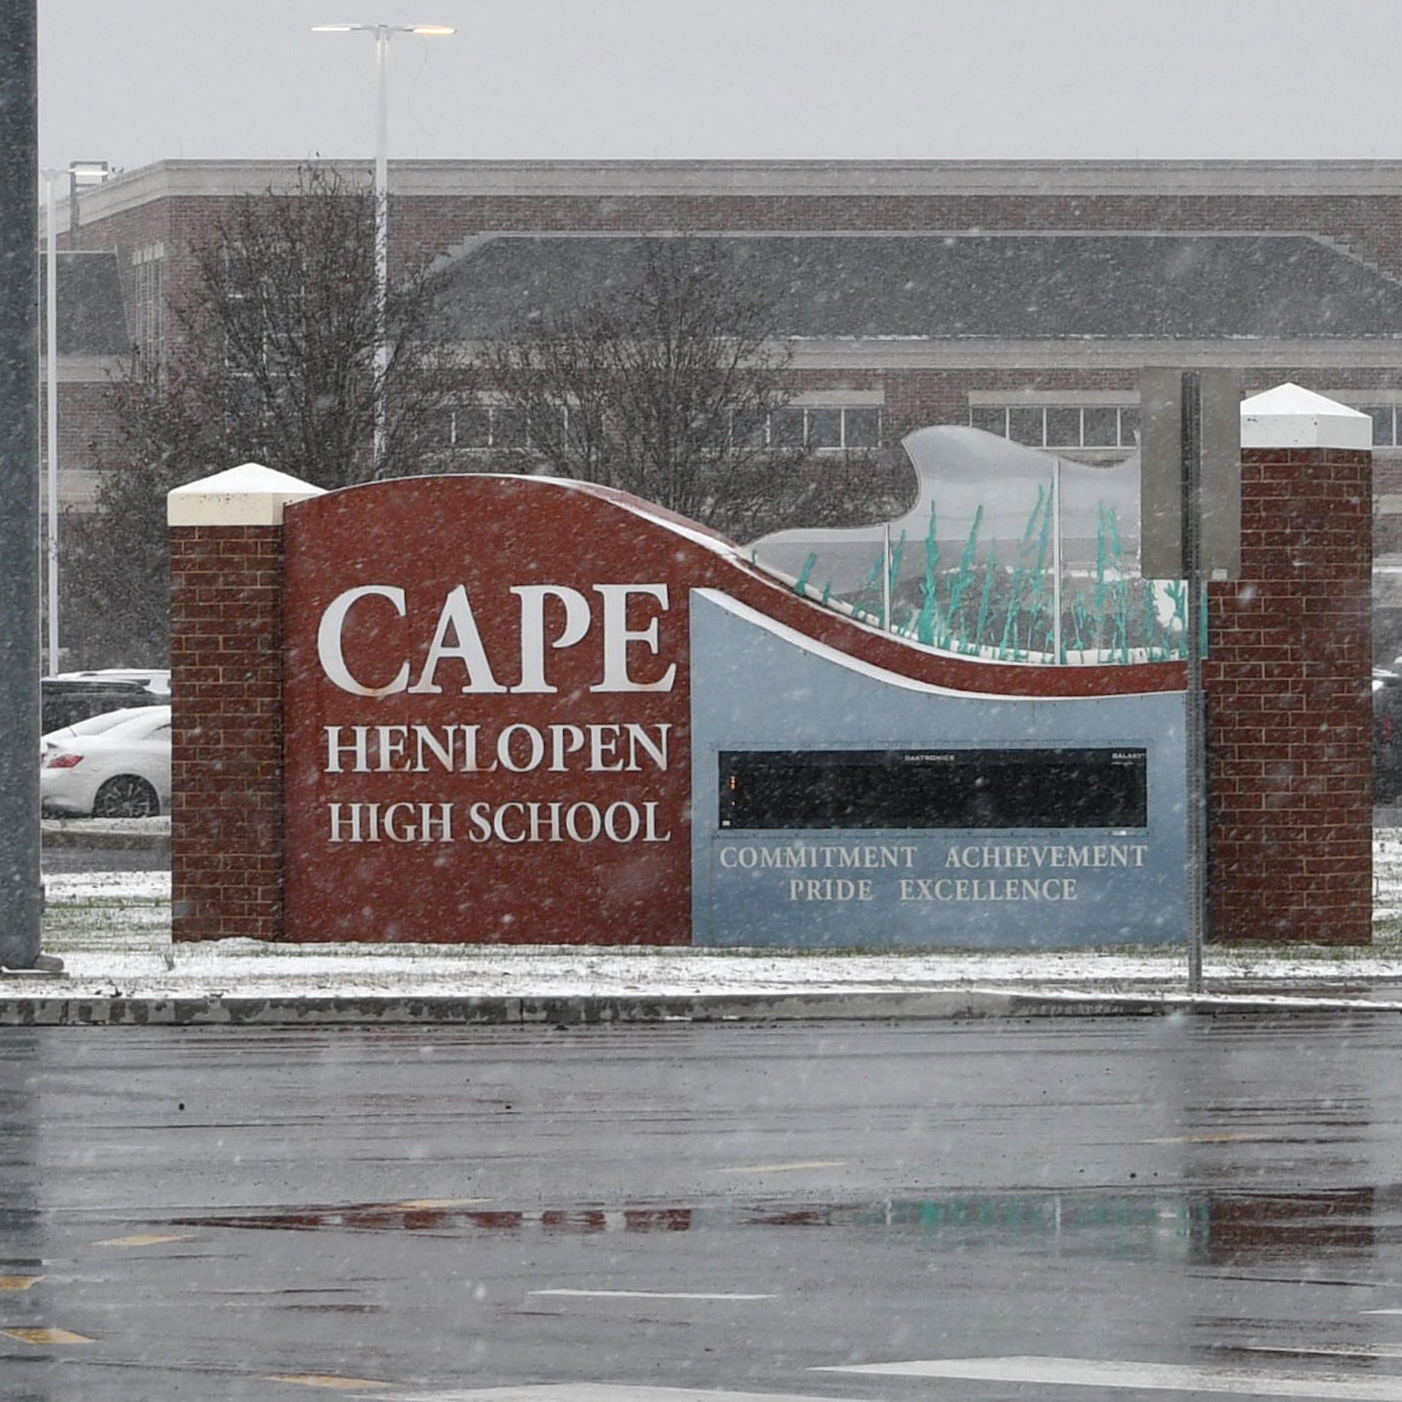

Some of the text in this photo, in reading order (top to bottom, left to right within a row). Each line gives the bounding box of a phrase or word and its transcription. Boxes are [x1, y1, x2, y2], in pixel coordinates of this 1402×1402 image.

[317, 583, 677, 697] CAPE
[323, 723, 672, 773] HENLOPEN
[327, 801, 672, 843] HIGH SCHOOL
[719, 845, 1148, 868] COMMITMENT ACHIEVEMENT
[790, 879, 1078, 901] PRIDE EXCELLENCE
